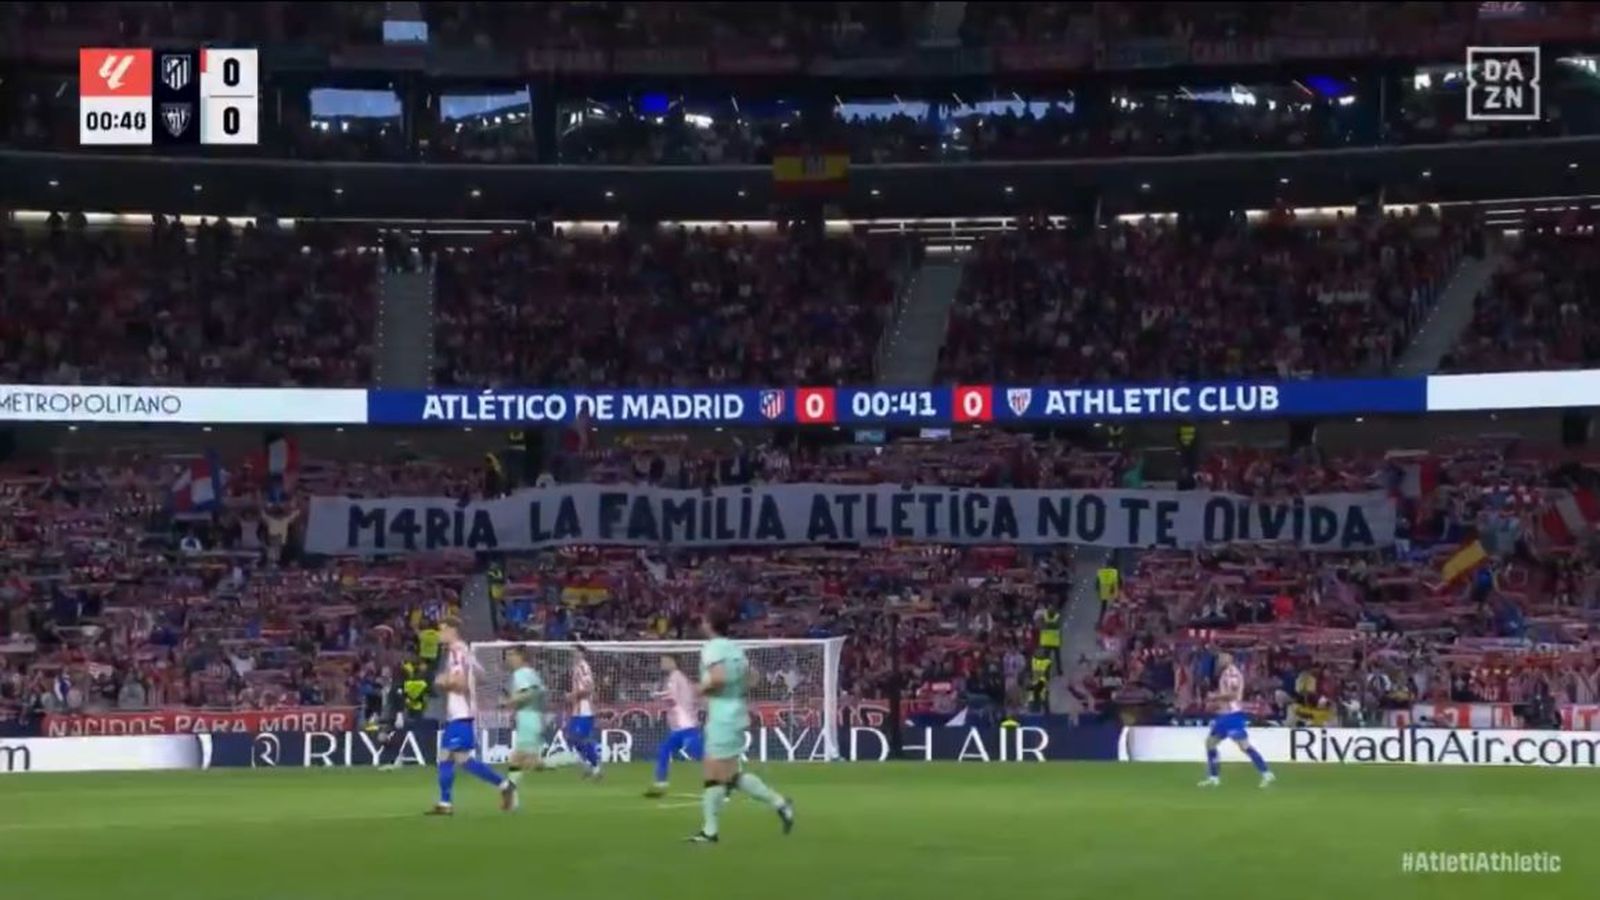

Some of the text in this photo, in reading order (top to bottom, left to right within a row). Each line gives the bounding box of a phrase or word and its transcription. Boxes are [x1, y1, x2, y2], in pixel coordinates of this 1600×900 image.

[422, 388, 745, 420] ATLÉTICO DE MADRID
[805, 394, 824, 418] 0
[852, 391, 937, 416] 00:41
[963, 391, 983, 416] 0
[1045, 385, 1280, 415] ATHLETIC CLUB
[347, 497, 498, 550] M4RÍA
[529, 496, 582, 543] LA
[1037, 493, 1106, 542] NO
[1120, 497, 1180, 547] TE
[174, 714, 248, 734] PARA
[957, 727, 1049, 762] AIR
